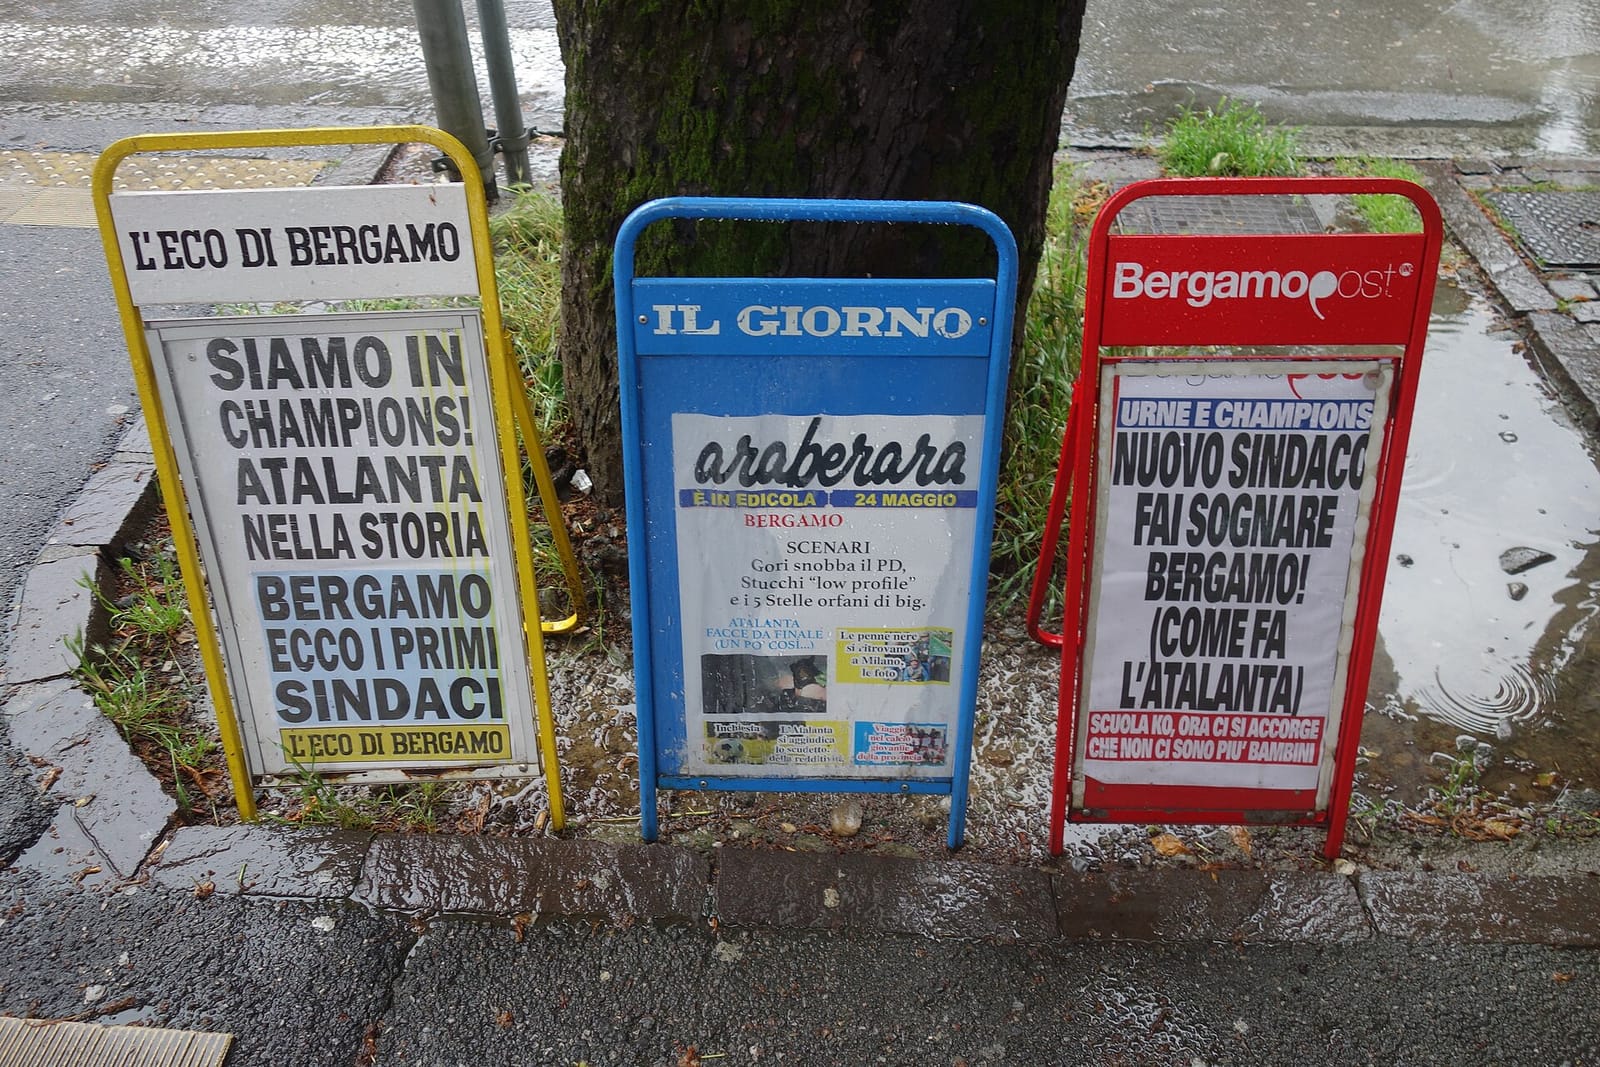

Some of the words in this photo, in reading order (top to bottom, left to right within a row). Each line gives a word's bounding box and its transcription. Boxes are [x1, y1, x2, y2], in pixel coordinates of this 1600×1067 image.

[129, 229, 228, 270] L'ECO
[235, 228, 279, 268] DI
[285, 221, 460, 268] BERGAMO
[652, 304, 720, 336] IL
[736, 304, 973, 339] GIORNO
[206, 335, 392, 391] SIAMO
[406, 335, 466, 387] IN
[219, 396, 474, 449] CHAMPIONS!
[1120, 400, 1193, 428] URNE
[1194, 401, 1211, 427] E
[1214, 401, 1374, 430] CHAMPIONS
[694, 416, 967, 488] araberara
[1112, 431, 1225, 489] NUOVO
[1228, 433, 1370, 491] SINDACO
[237, 455, 483, 505] ATALANTA
[711, 492, 730, 506] IN
[735, 492, 816, 507] EDICOLA
[854, 493, 877, 506] 24
[882, 493, 957, 507] MAGGIO
[744, 513, 843, 528] BERGAMO
[1134, 493, 1183, 546] FAI
[1187, 493, 1338, 548] SOGNARE
[241, 513, 356, 560] NELLA
[359, 511, 490, 559] STORIA
[786, 541, 871, 554] SCENARI
[751, 558, 788, 573] Gori
[793, 559, 855, 572] snobba
[861, 558, 871, 572] il
[877, 559, 906, 574] PD,
[1145, 552, 1310, 605] BERGAMO!
[257, 573, 492, 621] BERGAMO
[741, 576, 804, 590] Stucchi
[730, 596, 739, 606] e
[743, 594, 749, 606] i
[753, 596, 761, 609] 5
[766, 593, 813, 607] Stelle
[817, 594, 869, 607] orfani
[873, 594, 890, 607] di
[896, 595, 926, 611] big.
[706, 628, 749, 639] FACCE
[752, 630, 771, 640] DA
[774, 630, 824, 639] FINALE
[729, 618, 801, 628] ATALANTA
[840, 631, 855, 640] Le
[857, 633, 891, 642] penne
[893, 633, 918, 641] nere
[1150, 606, 1249, 663] (COME
[1250, 609, 1287, 659] FA
[265, 627, 364, 673] ECCO
[371, 627, 385, 670] I
[391, 626, 499, 670] PRIMI
[715, 639, 740, 650] (UN
[846, 644, 855, 653] si
[862, 668, 872, 677] le
[874, 668, 896, 678] foto
[275, 676, 504, 723] SINDACI
[1119, 661, 1304, 717] L'ATALANTA)
[1090, 714, 1150, 735] SCUOLA
[1152, 716, 1176, 737] KO,
[1178, 716, 1210, 737] ORA
[1213, 716, 1229, 737] CI
[1231, 717, 1247, 738] SI
[1248, 717, 1320, 740] ACCORGE
[289, 733, 353, 757] L'ECO
[358, 732, 385, 756] DI
[390, 730, 503, 755] BERGAMO
[1089, 737, 1118, 758] CHE
[1120, 737, 1153, 759] NON
[1155, 738, 1171, 759] CI
[1173, 738, 1216, 760] SONO
[1216, 740, 1247, 760] PIU'
[1248, 741, 1315, 763] BAMBINI
